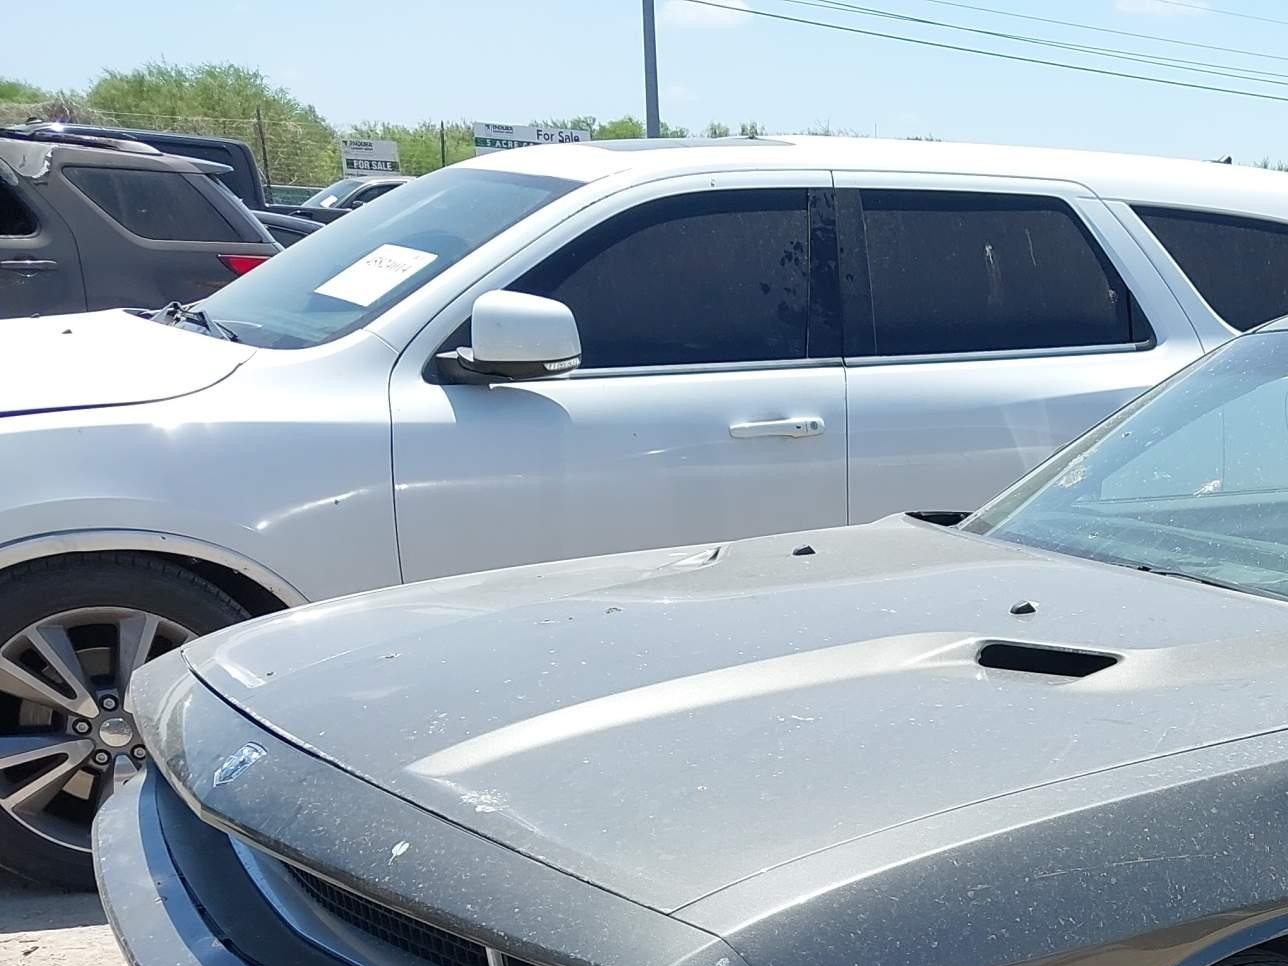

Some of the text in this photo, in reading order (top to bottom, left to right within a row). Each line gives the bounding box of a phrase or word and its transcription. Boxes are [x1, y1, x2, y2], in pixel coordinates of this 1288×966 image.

[536, 129, 581, 143] For Sale
[495, 140, 519, 148] ACRE
[353, 160, 393, 171] FOR SALE
